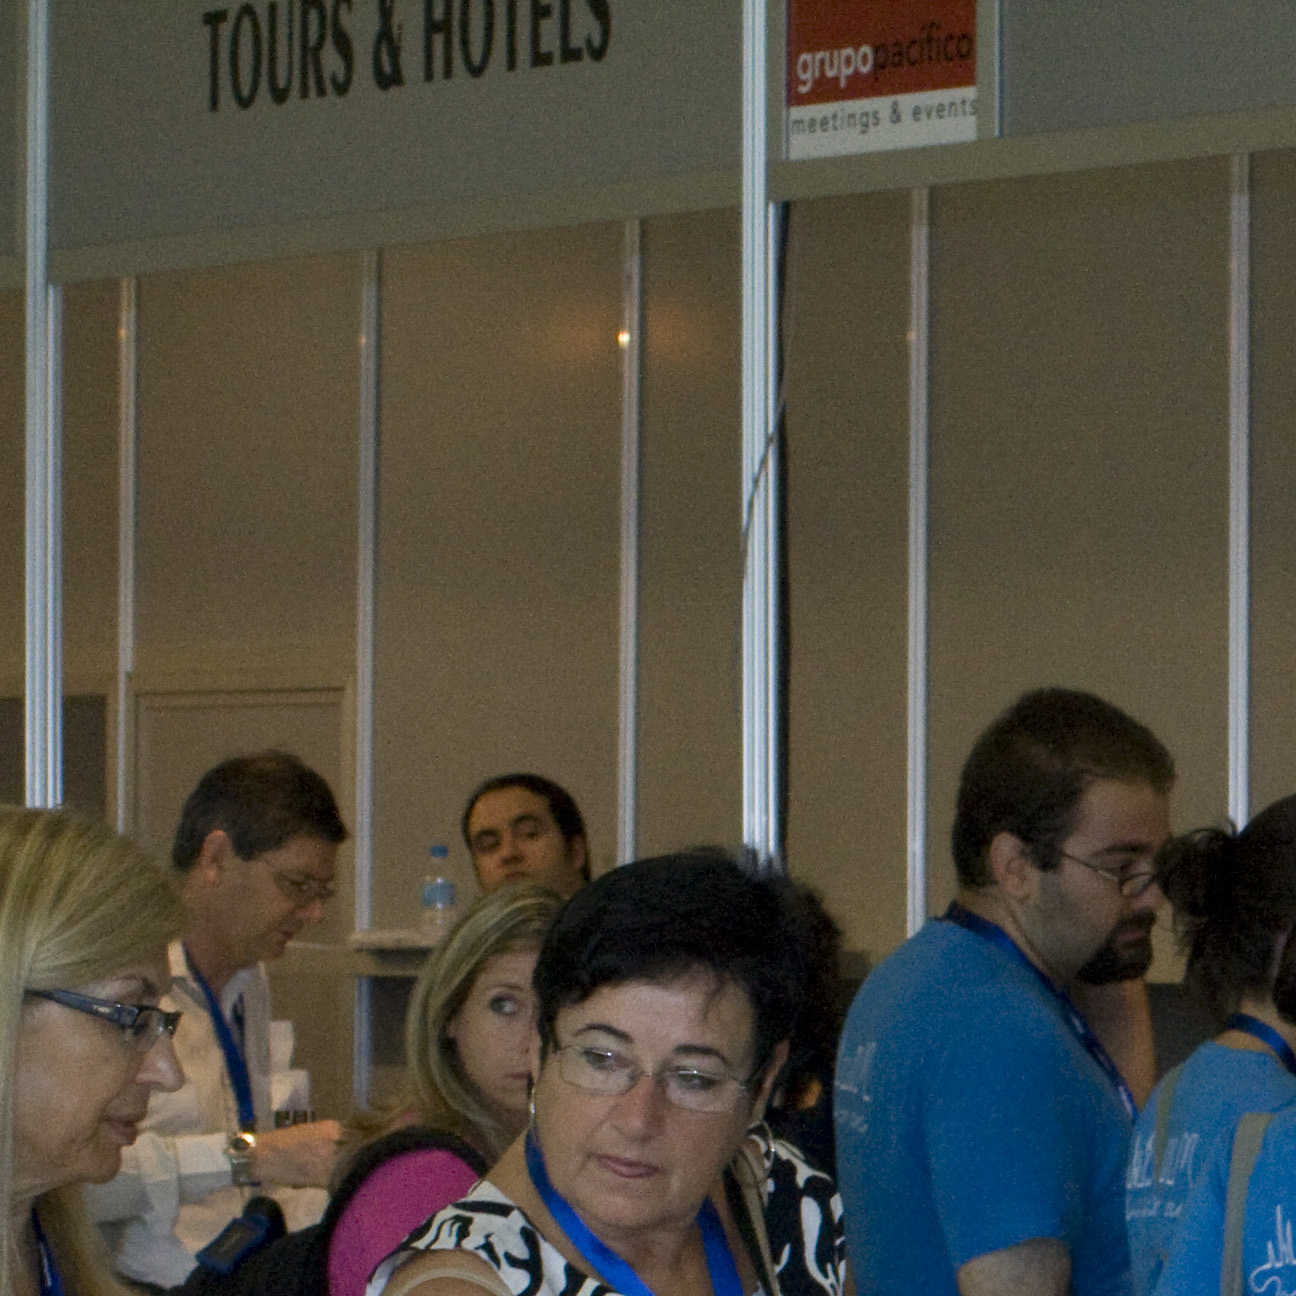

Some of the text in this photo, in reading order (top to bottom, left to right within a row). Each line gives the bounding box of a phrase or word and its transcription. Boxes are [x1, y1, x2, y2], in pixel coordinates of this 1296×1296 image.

[203, 0, 612, 112] TOURS & HOTELS
[791, 98, 978, 135] meetings & events
